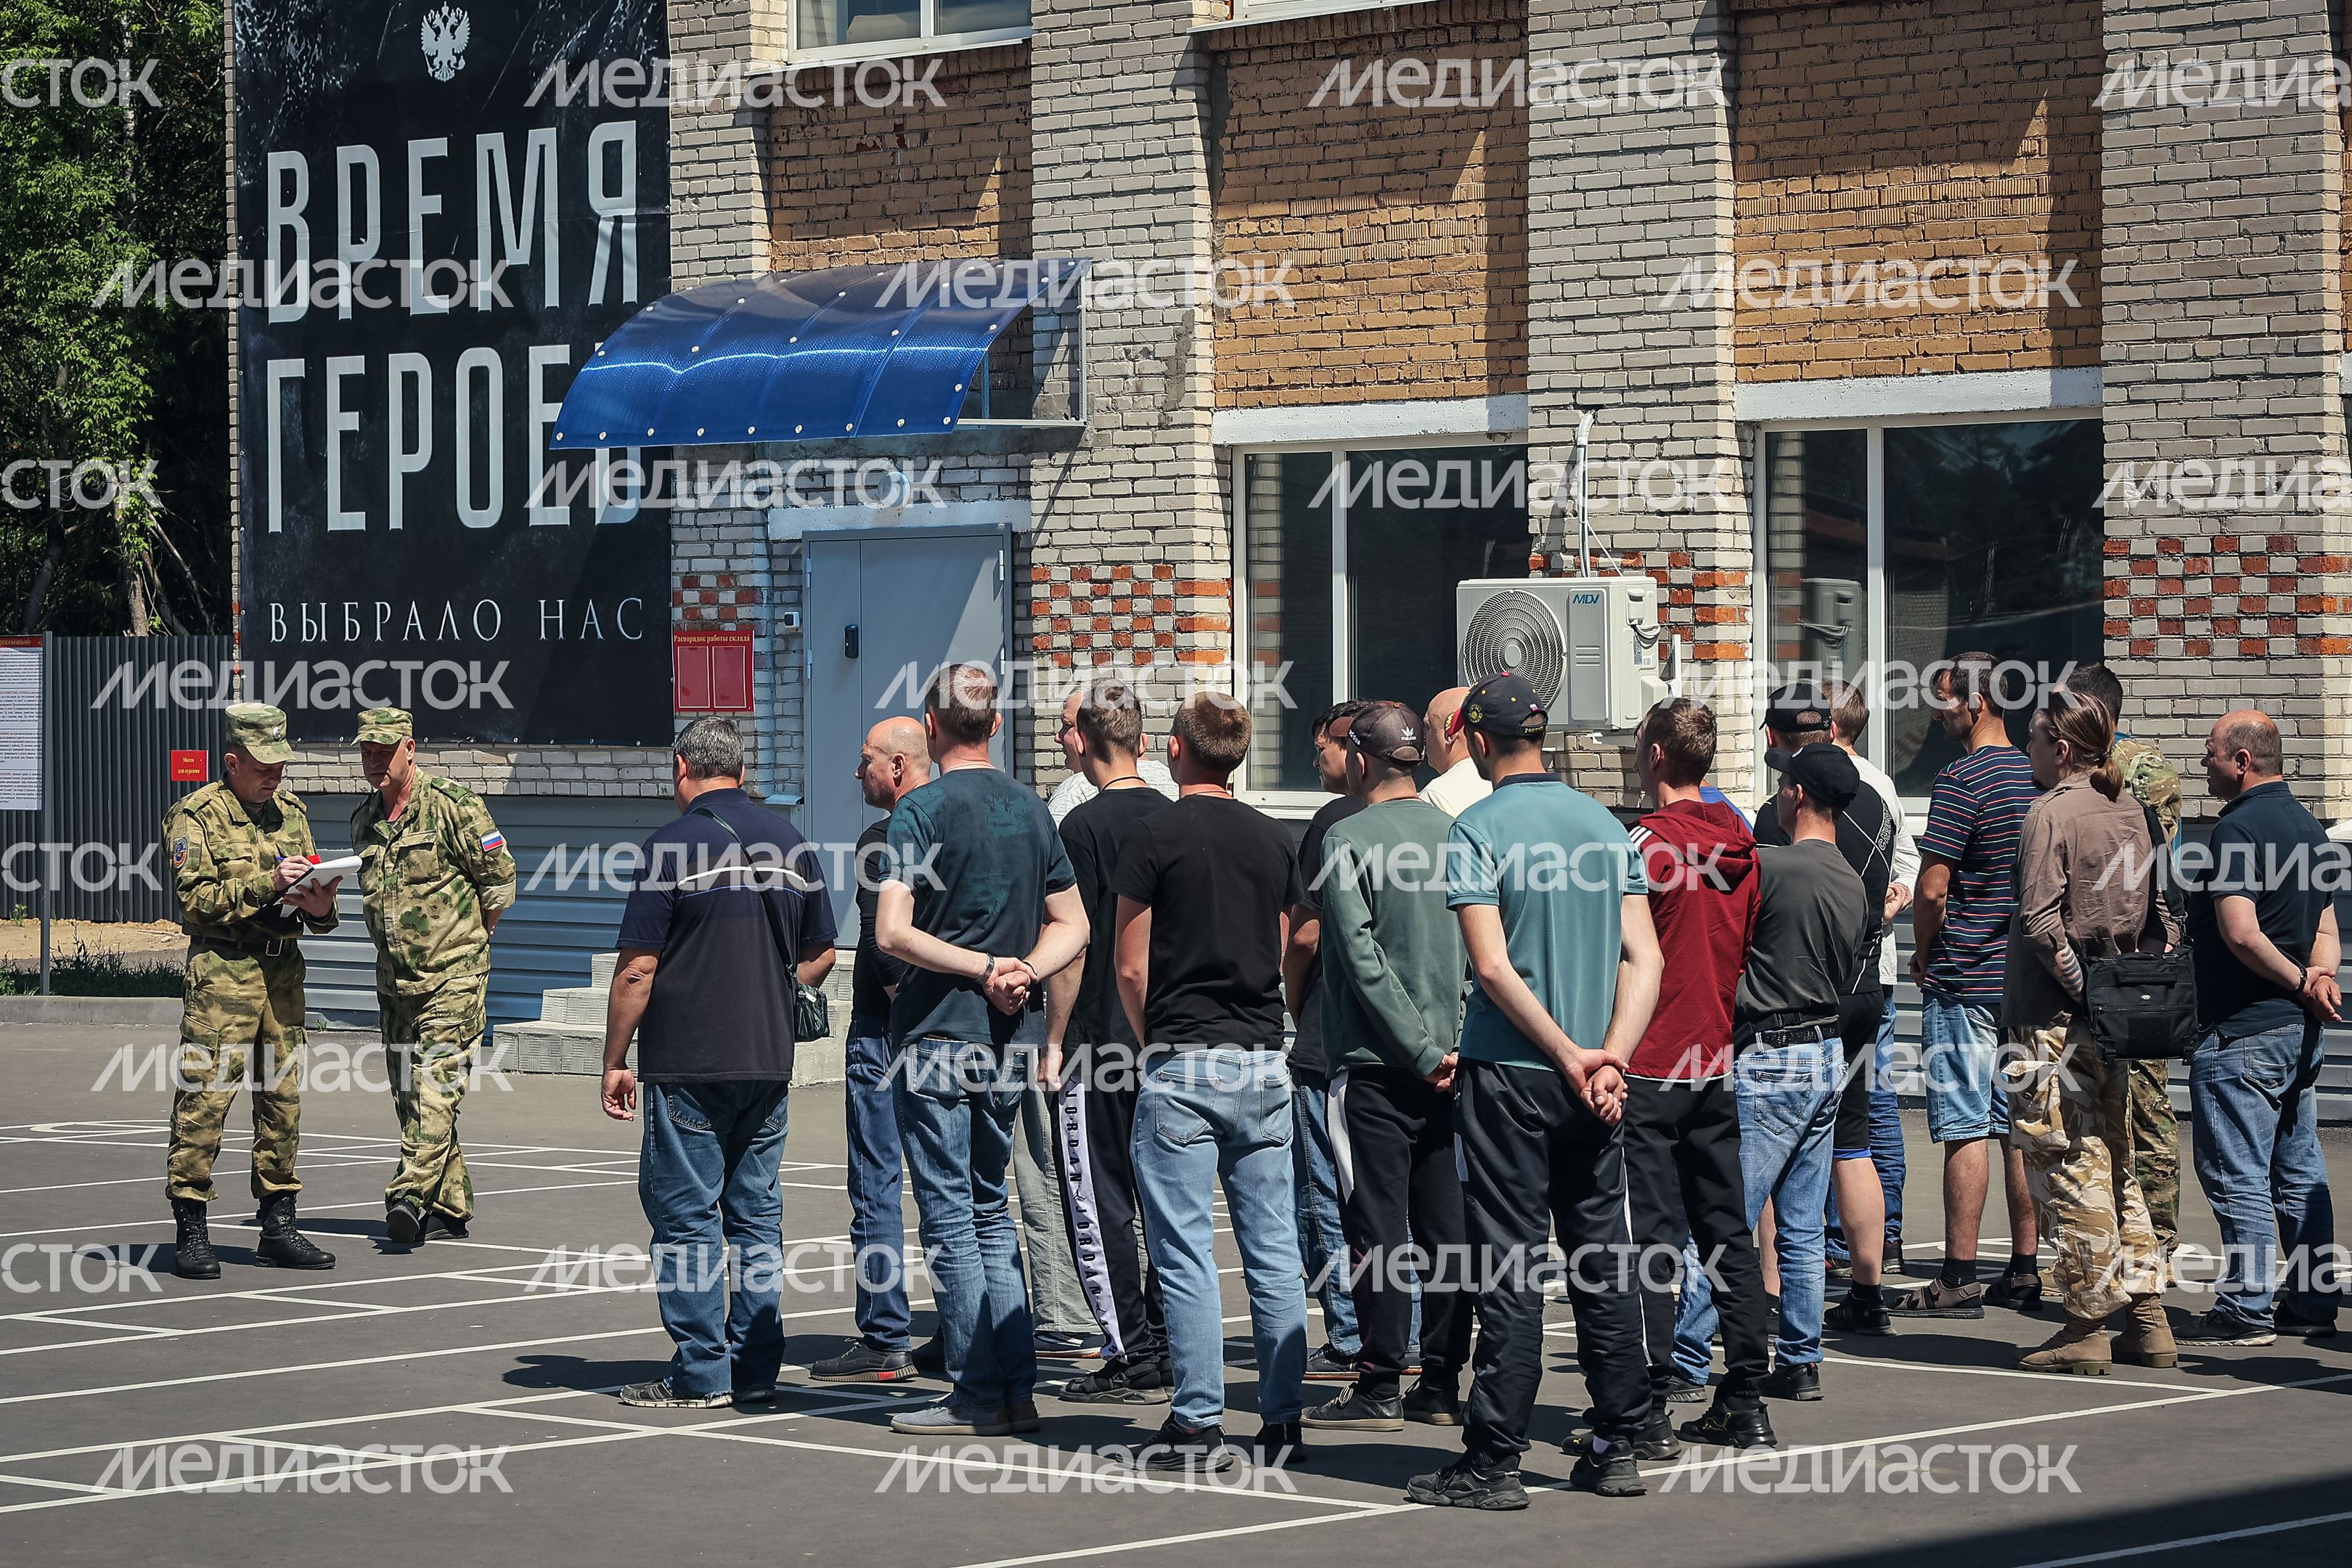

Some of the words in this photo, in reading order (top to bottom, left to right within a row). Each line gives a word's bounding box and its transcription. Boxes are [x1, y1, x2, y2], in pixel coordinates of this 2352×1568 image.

[267, 120, 639, 324] ВРЕМЯ
[1572, 594, 1600, 604] MDV
[269, 597, 501, 643] ВЫБРАЛО
[539, 596, 644, 642] НАС
[674, 634, 707, 644] Распорядок
[707, 634, 728, 644] работы
